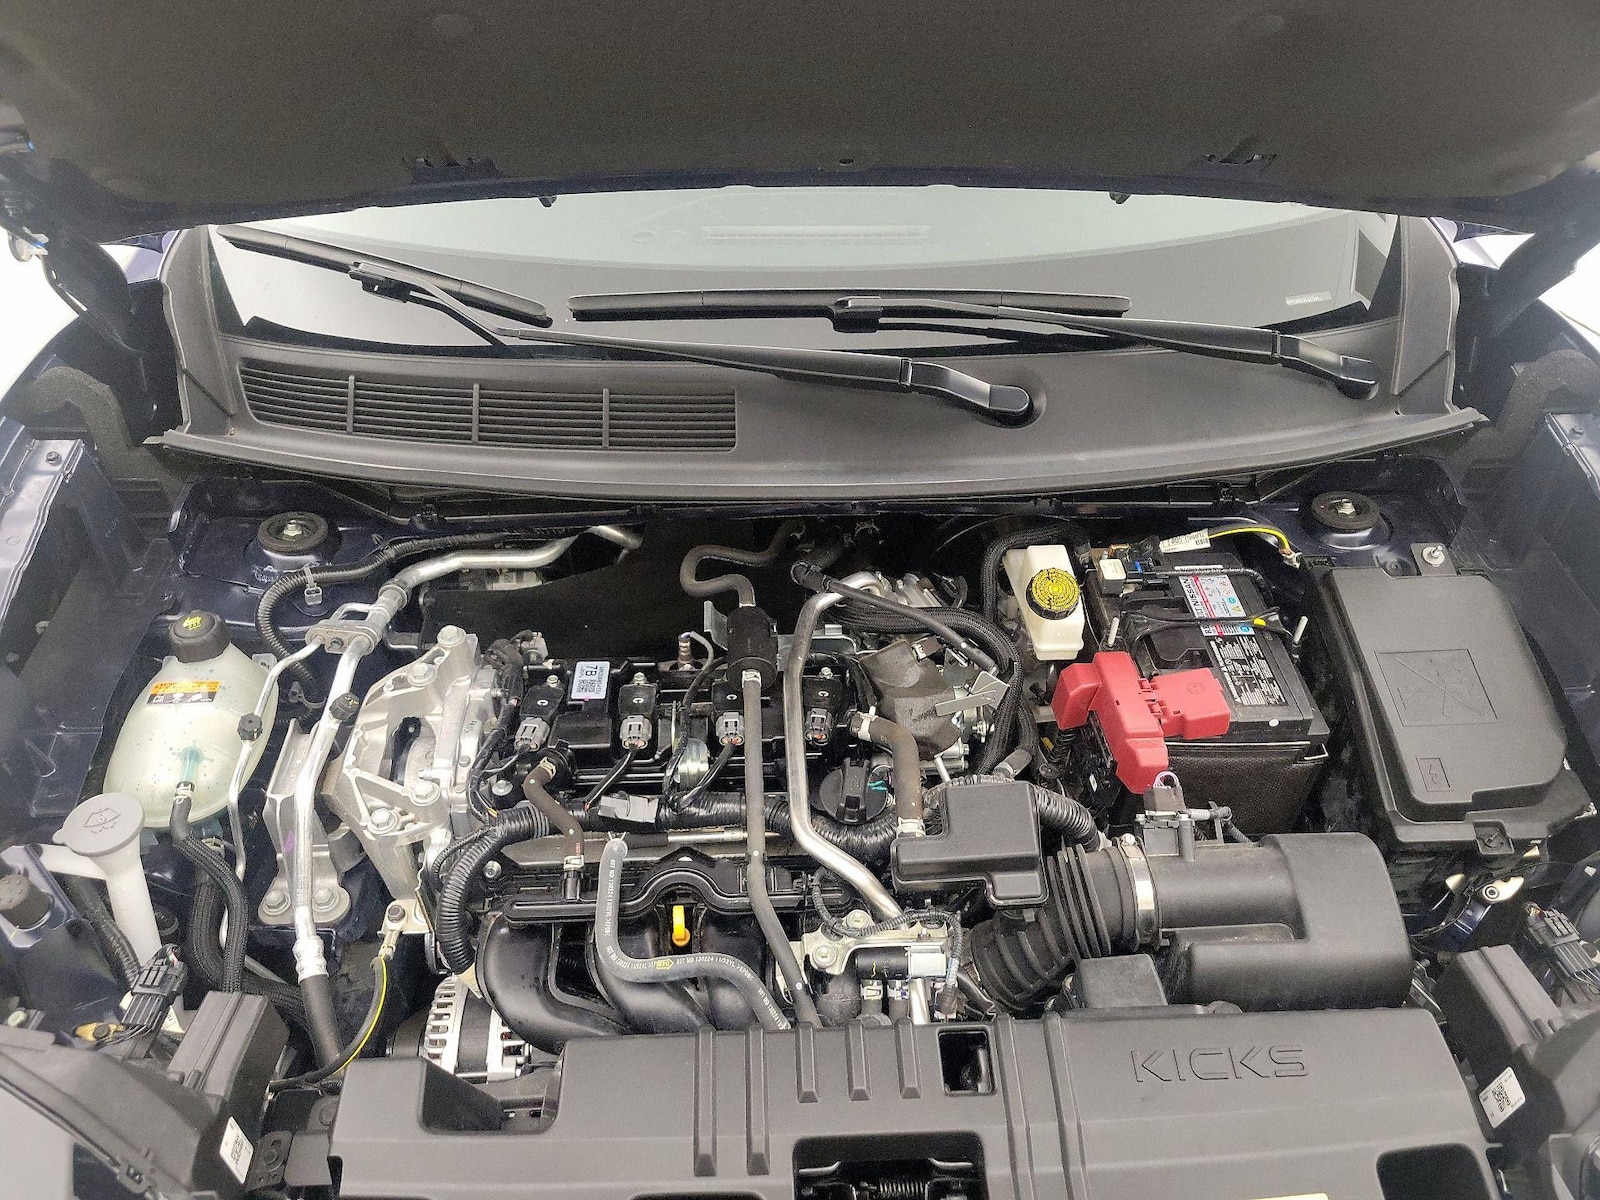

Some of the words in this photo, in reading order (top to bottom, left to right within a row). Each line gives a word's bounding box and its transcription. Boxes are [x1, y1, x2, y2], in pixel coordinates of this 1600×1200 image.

[1182, 578, 1200, 607] NISSAN
[585, 665, 598, 677] 7B
[1131, 1045, 1309, 1082] KICKS
